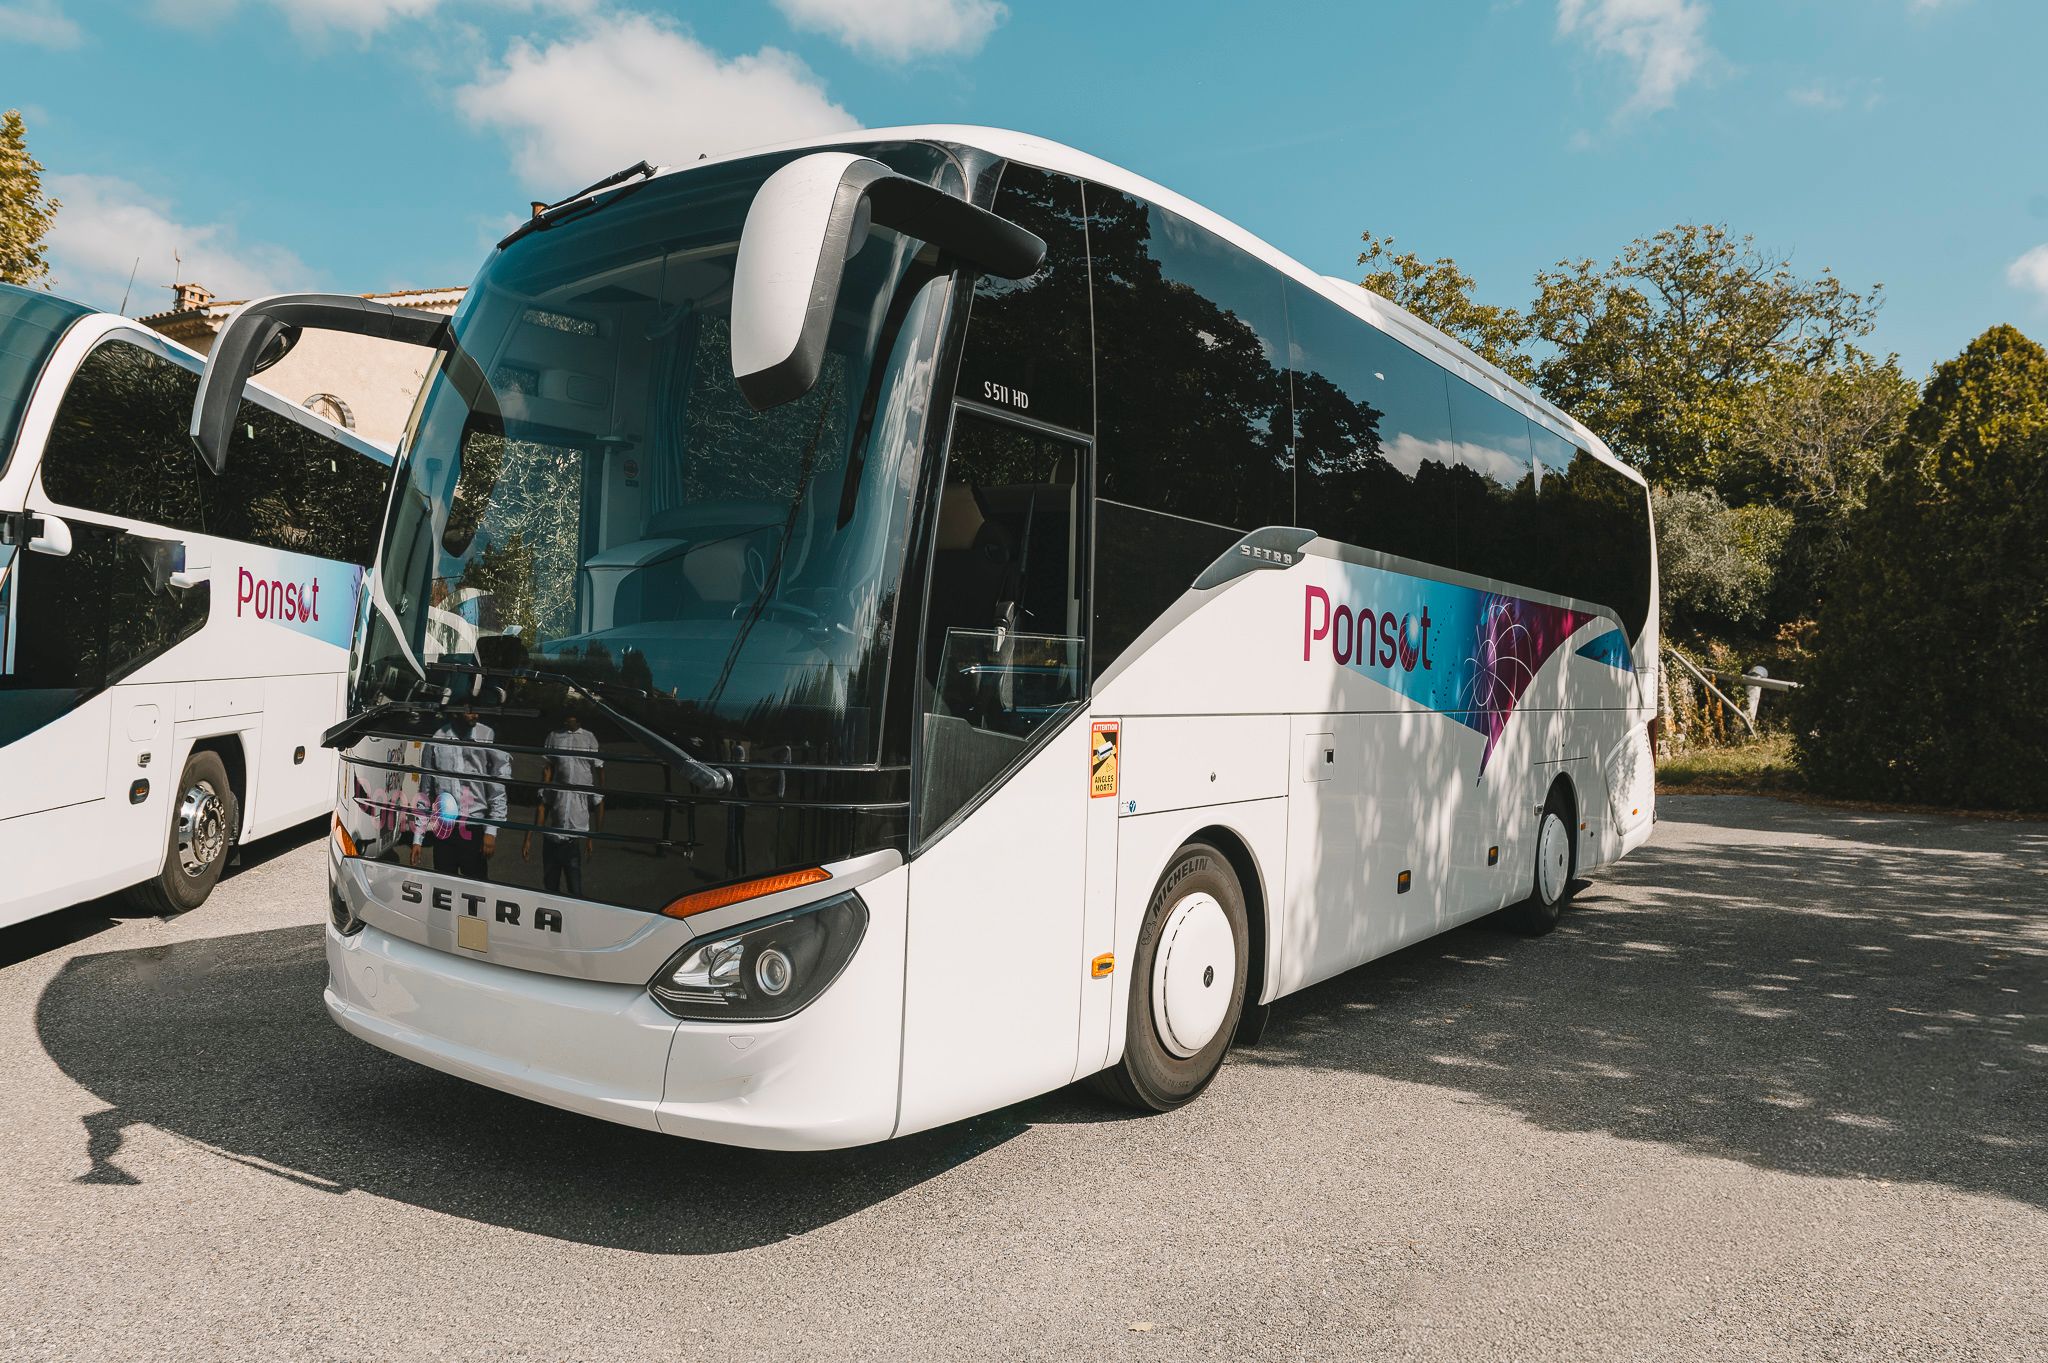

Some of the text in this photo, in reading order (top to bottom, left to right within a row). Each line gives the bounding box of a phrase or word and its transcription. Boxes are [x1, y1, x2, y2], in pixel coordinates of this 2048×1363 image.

[1012, 389, 1029, 409] HD
[1240, 544, 1293, 564] SETRA
[237, 566, 319, 623] Ponsot
[1303, 585, 1433, 672] Ponsot
[1095, 775, 1114, 784] ANGLES
[1095, 784, 1113, 792] MORTS
[401, 880, 563, 933] SETRA
[1152, 858, 1208, 919] MICHELIN
